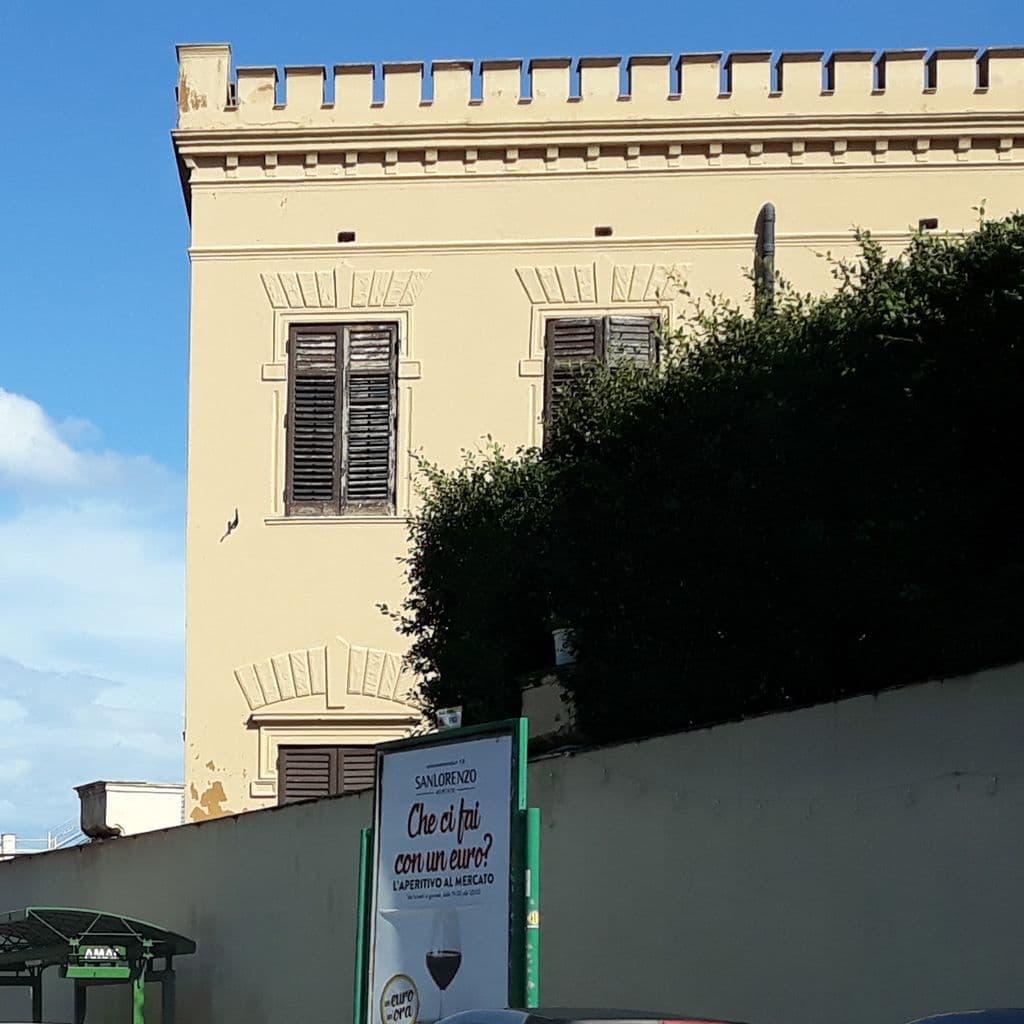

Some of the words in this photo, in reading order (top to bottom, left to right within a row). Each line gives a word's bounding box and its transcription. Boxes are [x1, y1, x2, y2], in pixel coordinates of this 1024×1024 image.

[415, 768, 477, 790] SANLORENZO
[408, 802, 437, 838] Che
[440, 804, 456, 833] ci
[457, 797, 481, 845] fai
[394, 852, 424, 875] con
[426, 850, 447, 873] un
[449, 832, 493, 870] euro?
[392, 877, 442, 891] L'APERITIVO
[443, 876, 453, 888] AL
[455, 872, 494, 887] MERCATO
[391, 989, 414, 1008] euro
